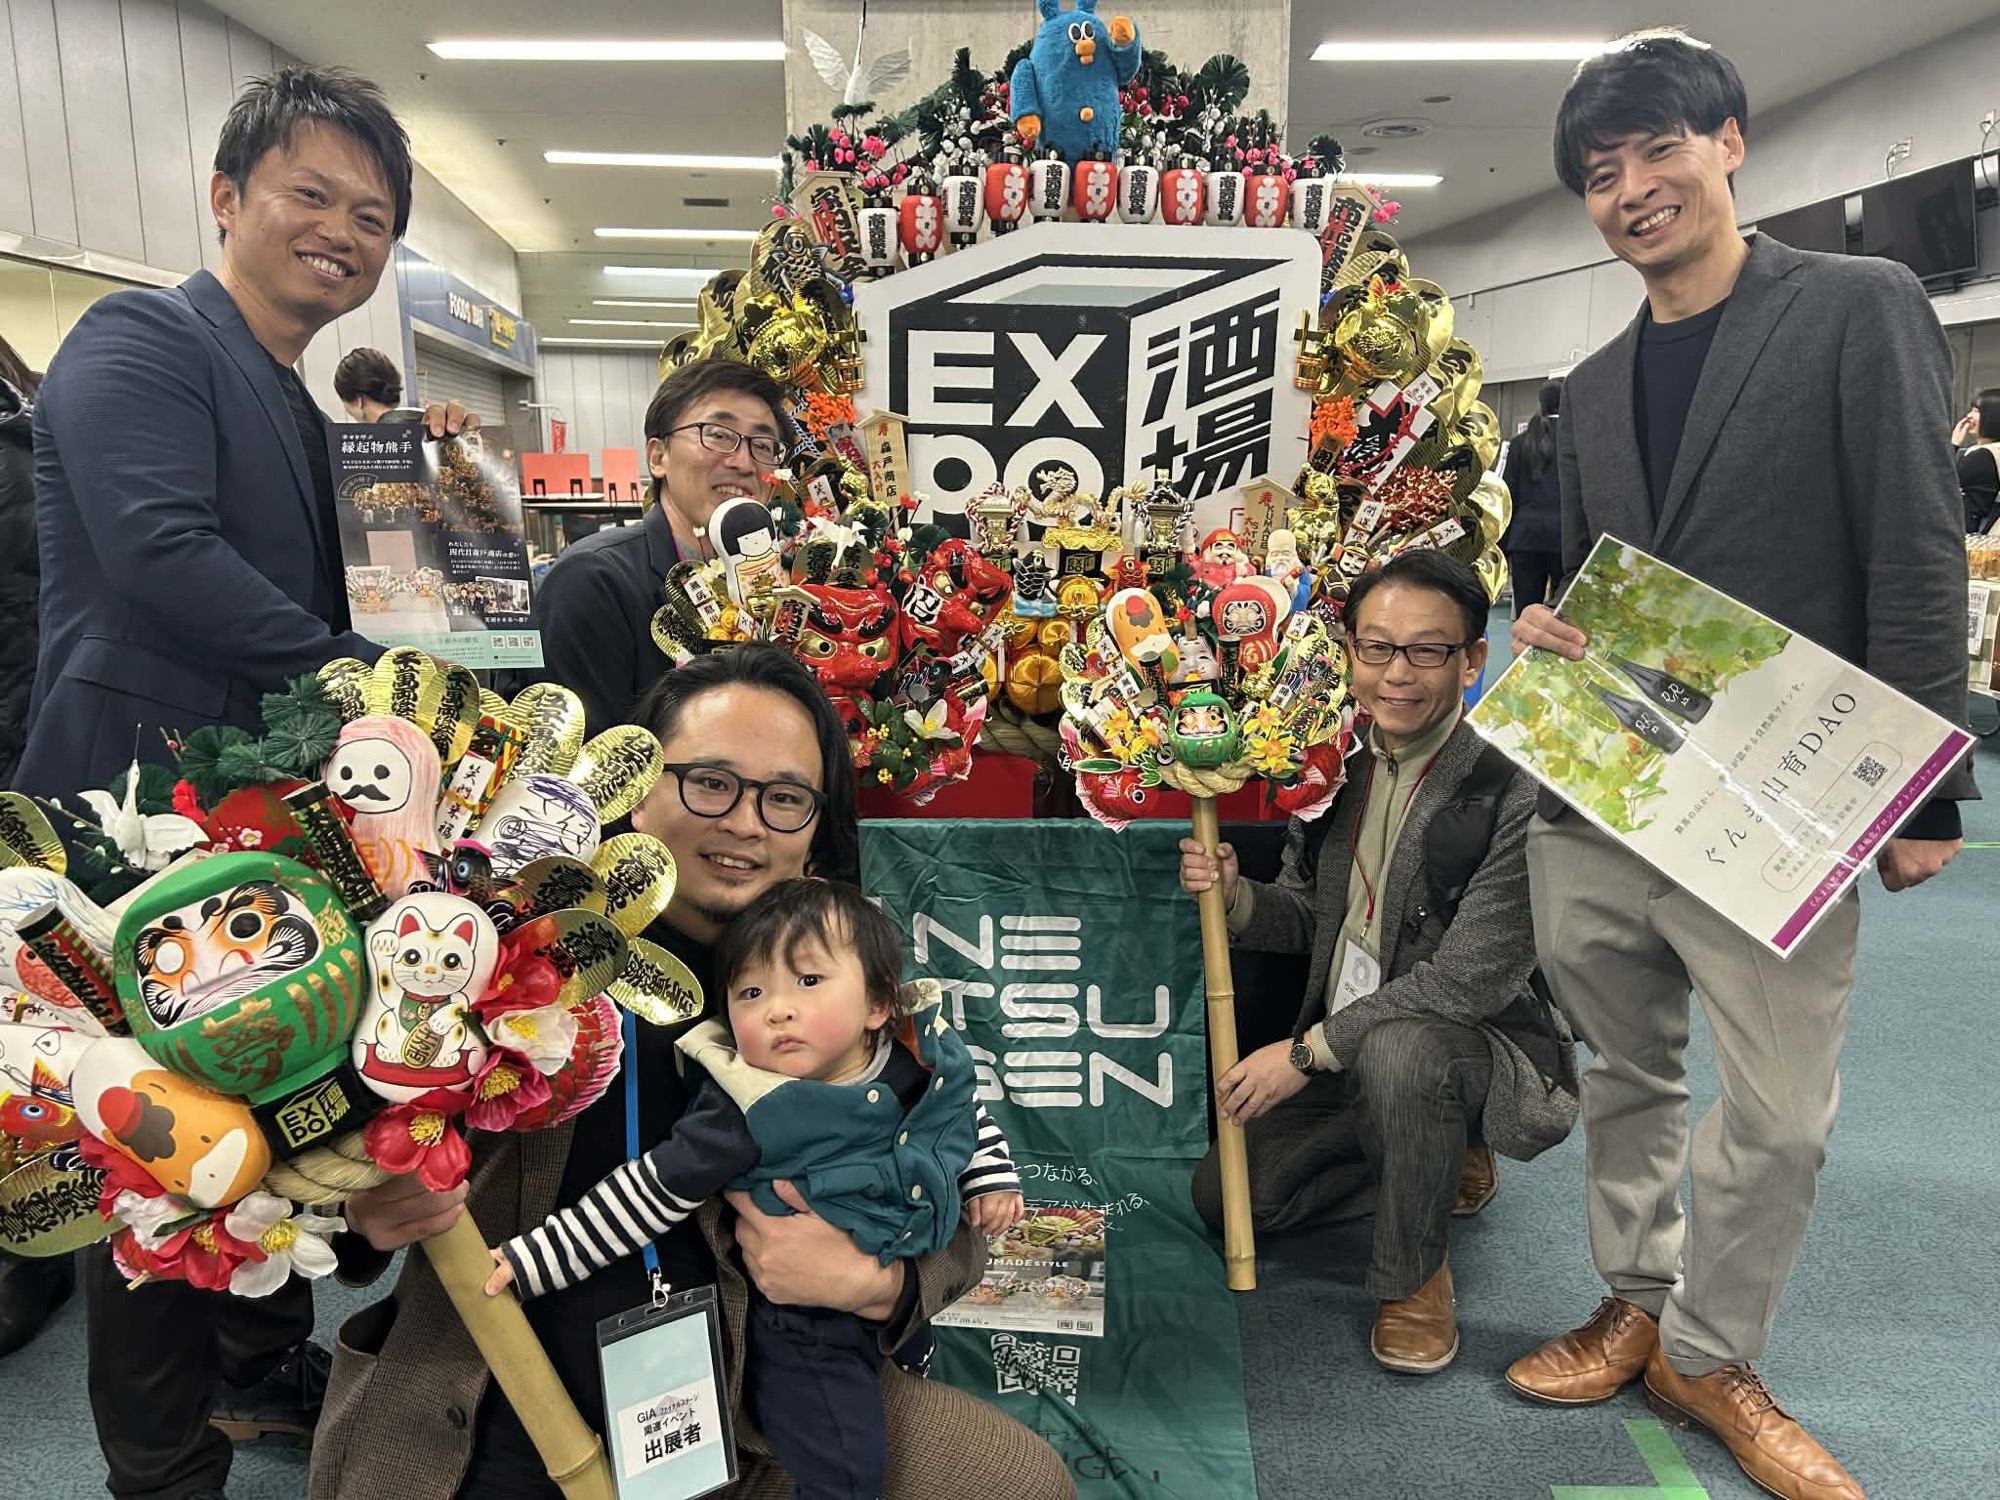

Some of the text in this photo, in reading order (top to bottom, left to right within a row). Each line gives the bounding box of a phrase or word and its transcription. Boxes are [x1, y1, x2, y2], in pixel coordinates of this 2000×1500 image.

[907, 329, 1108, 428] EX
[1141, 288, 1281, 500] 酒場
[341, 440, 413, 454] 縁起物熊手
[907, 433, 1105, 526] PO
[1249, 521, 1259, 548] STY
[1259, 505, 1275, 549] KUMADE
[1704, 692, 1857, 864] ぐんま山育DAO
[912, 911, 1082, 970] NE
[938, 977, 1170, 1039] TSU
[281, 1101, 320, 1130] EX
[288, 1117, 326, 1143] PO
[637, 1407, 657, 1424] GIA
[643, 1407, 697, 1437] 関連イベント
[644, 1422, 702, 1464] 出展者
